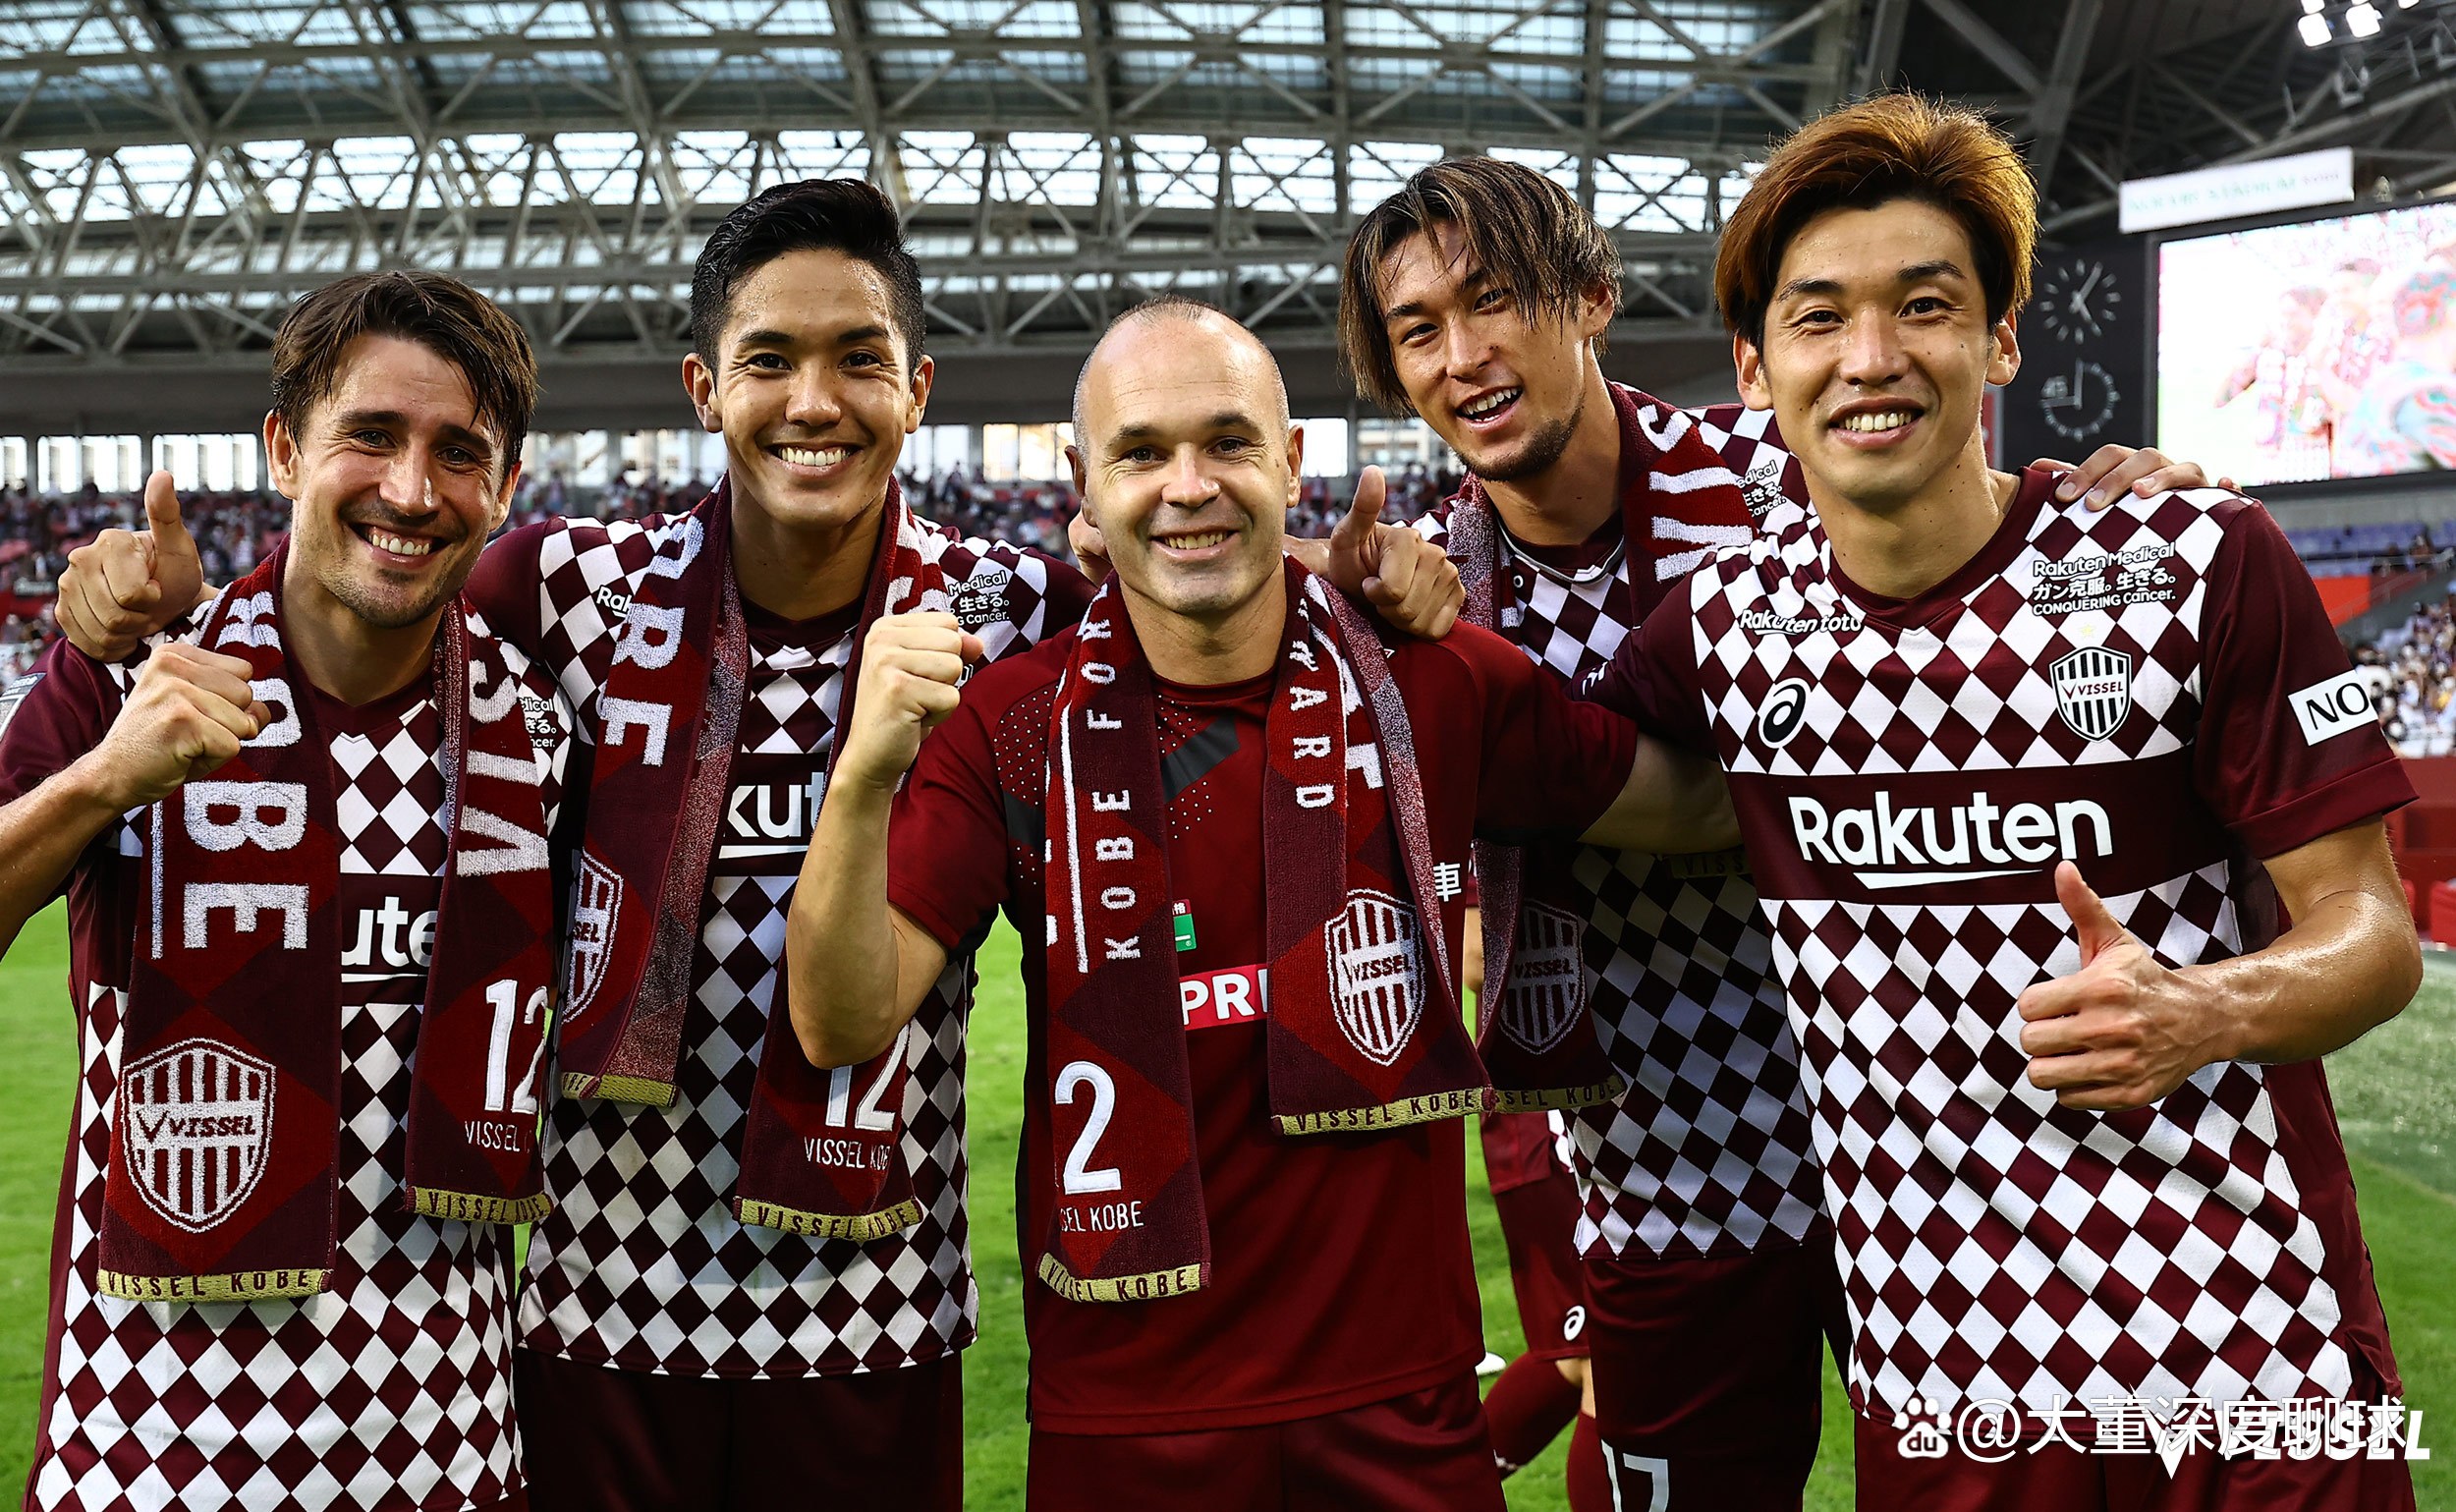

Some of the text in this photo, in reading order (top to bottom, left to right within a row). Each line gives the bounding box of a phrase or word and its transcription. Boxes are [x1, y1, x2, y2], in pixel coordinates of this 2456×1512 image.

[1736, 460, 1778, 489] edical
[1749, 494, 1786, 518] ancer.
[2035, 541, 2175, 577] Rakuten Medical
[949, 571, 1008, 596] Medical
[2034, 567, 2176, 600] ガン克服。 生きる。
[2034, 588, 2176, 615] CONQUERING Cancer.
[966, 610, 1010, 625] Cancer.
[1740, 609, 1817, 634] Rakuten
[2078, 681, 2125, 696] VISSEL
[520, 698, 554, 711] dical
[530, 738, 556, 748] ncer.
[1788, 790, 2113, 866] Rakuten
[1092, 787, 1141, 961] KOBE
[485, 979, 548, 1115] 12
[1296, 1090, 1474, 1132] VISSEL KOBE
[169, 1116, 255, 1139] VISSEL
[465, 1121, 521, 1153] VISSEL
[804, 1136, 865, 1169] VISSEL
[427, 1191, 507, 1222] VISSEL
[757, 1205, 853, 1238] VISSEL
[1090, 1201, 1144, 1232] KOBE
[108, 1270, 309, 1297] VISSEL KOBE
[1116, 1268, 1188, 1302] KOBE
